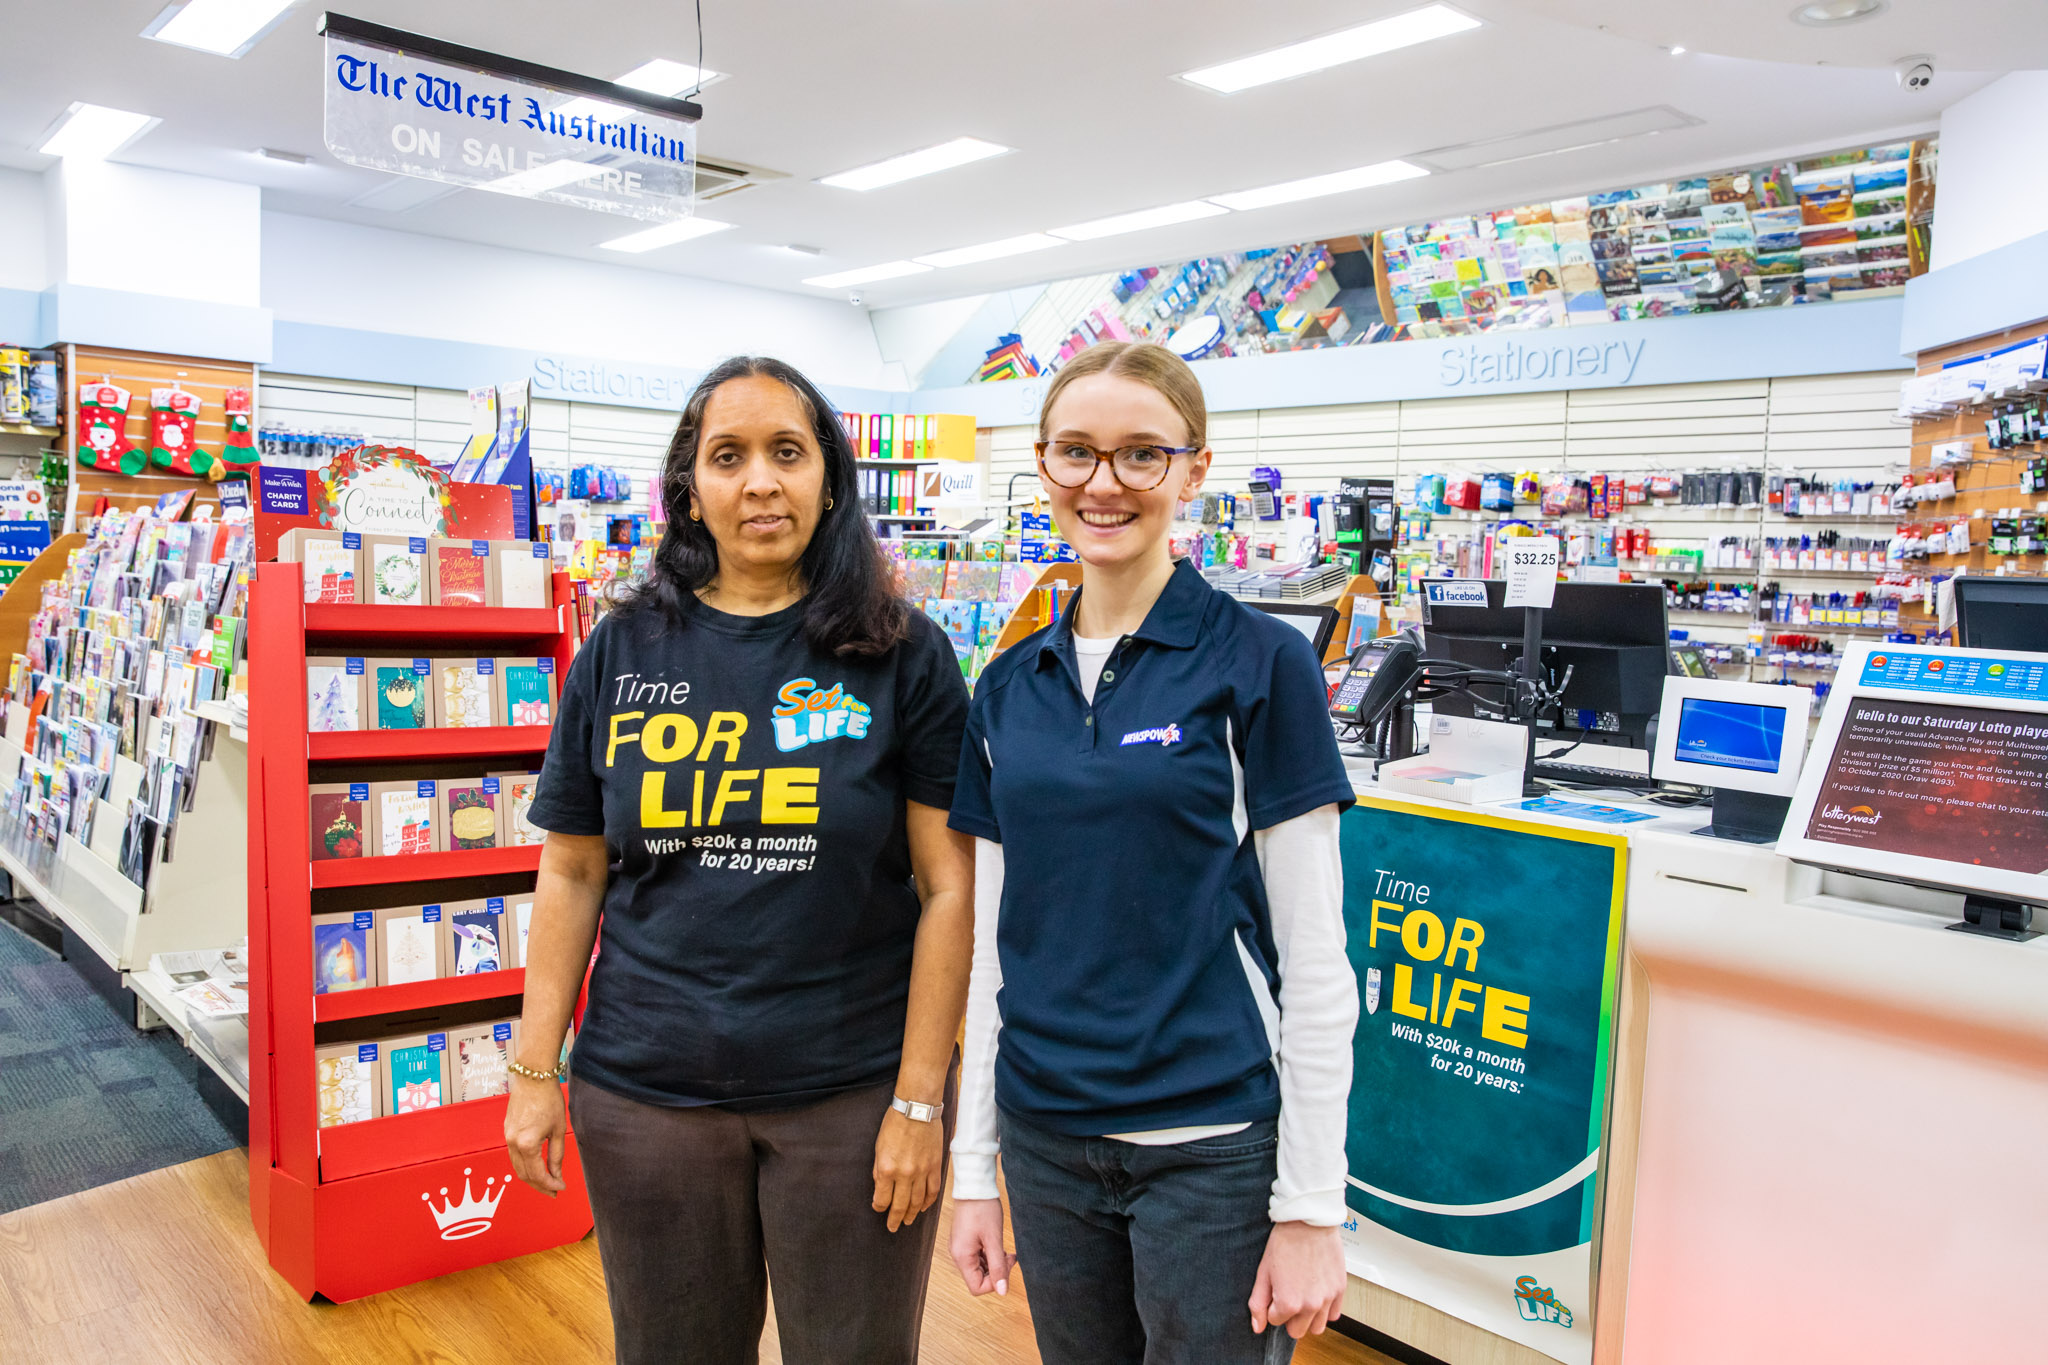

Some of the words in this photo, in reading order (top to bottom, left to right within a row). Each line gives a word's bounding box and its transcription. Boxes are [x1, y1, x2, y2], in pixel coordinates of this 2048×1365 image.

[336, 54, 409, 101] The
[415, 72, 511, 125] West
[518, 97, 688, 163] Australian
[391, 124, 440, 159] ON
[1440, 338, 1647, 386] Stationery
[266, 492, 303, 501] CHARITY
[942, 474, 974, 493] Quill
[271, 501, 299, 509] CARDS
[344, 487, 437, 526] Connect
[1514, 552, 1556, 566] $32.25
[1446, 590, 1485, 602] facebook
[615, 673, 690, 705] Time
[775, 680, 842, 718] Set
[841, 696, 867, 714] for
[774, 709, 868, 751] LIFE
[1852, 725, 1874, 733] Some
[1885, 728, 1903, 736] your
[1905, 731, 1927, 739] usual
[1928, 732, 1965, 743] Advance
[1967, 736, 1985, 746] Play
[1856, 709, 1886, 722] Hello
[1887, 712, 1899, 723] to
[1901, 715, 1921, 726] our
[1923, 715, 1978, 733] Saturday
[1979, 720, 2012, 734] Lotto
[605, 711, 749, 768] FOR
[1849, 733, 1893, 745] temporarily
[1895, 738, 1942, 750] unavailable,
[1945, 743, 1967, 752] while
[1984, 748, 2005, 756] work
[1840, 757, 1872, 767] Division
[1879, 762, 1899, 772] prize
[1910, 765, 1921, 773] $5
[1959, 771, 1975, 780] The
[1976, 773, 1994, 782] first
[1995, 776, 2018, 785] draw
[1847, 767, 1880, 777] October
[1881, 771, 1902, 780] 2020
[1903, 773, 1929, 783] (Draw
[1930, 778, 1956, 788] 4093).
[1894, 754, 1907, 762] the
[1909, 757, 1932, 767] game
[1933, 760, 1949, 768] you
[1951, 761, 1974, 770] know
[1976, 764, 1993, 773] and
[1994, 766, 2013, 775] love
[2015, 769, 2035, 778] with
[640, 767, 820, 829] LIFE
[1838, 784, 1860, 792] you'd
[1861, 785, 1876, 794] like
[1887, 788, 1904, 798] find
[1920, 795, 1944, 804] more,
[1946, 797, 1975, 807] please
[1976, 801, 1997, 810] chat
[2008, 806, 2031, 815] your
[1821, 803, 1883, 826] lotterywest
[644, 838, 687, 855] With
[691, 833, 737, 850] $20k
[740, 838, 752, 850] a
[756, 834, 818, 852] month
[699, 851, 726, 869] for
[728, 854, 752, 871] 20
[753, 855, 816, 875] years!
[1374, 868, 1430, 905] Time
[1369, 898, 1485, 972] FOR
[1391, 962, 1531, 1050] LIFE
[1391, 1022, 1423, 1045] With
[1425, 1032, 1461, 1056] $20k
[1463, 1046, 1473, 1057] a
[1476, 1047, 1526, 1075] month
[1431, 1053, 1452, 1073] for
[1453, 1061, 1474, 1080] 20
[1515, 1276, 1553, 1305] Set
[1516, 1297, 1573, 1328] LIFE
